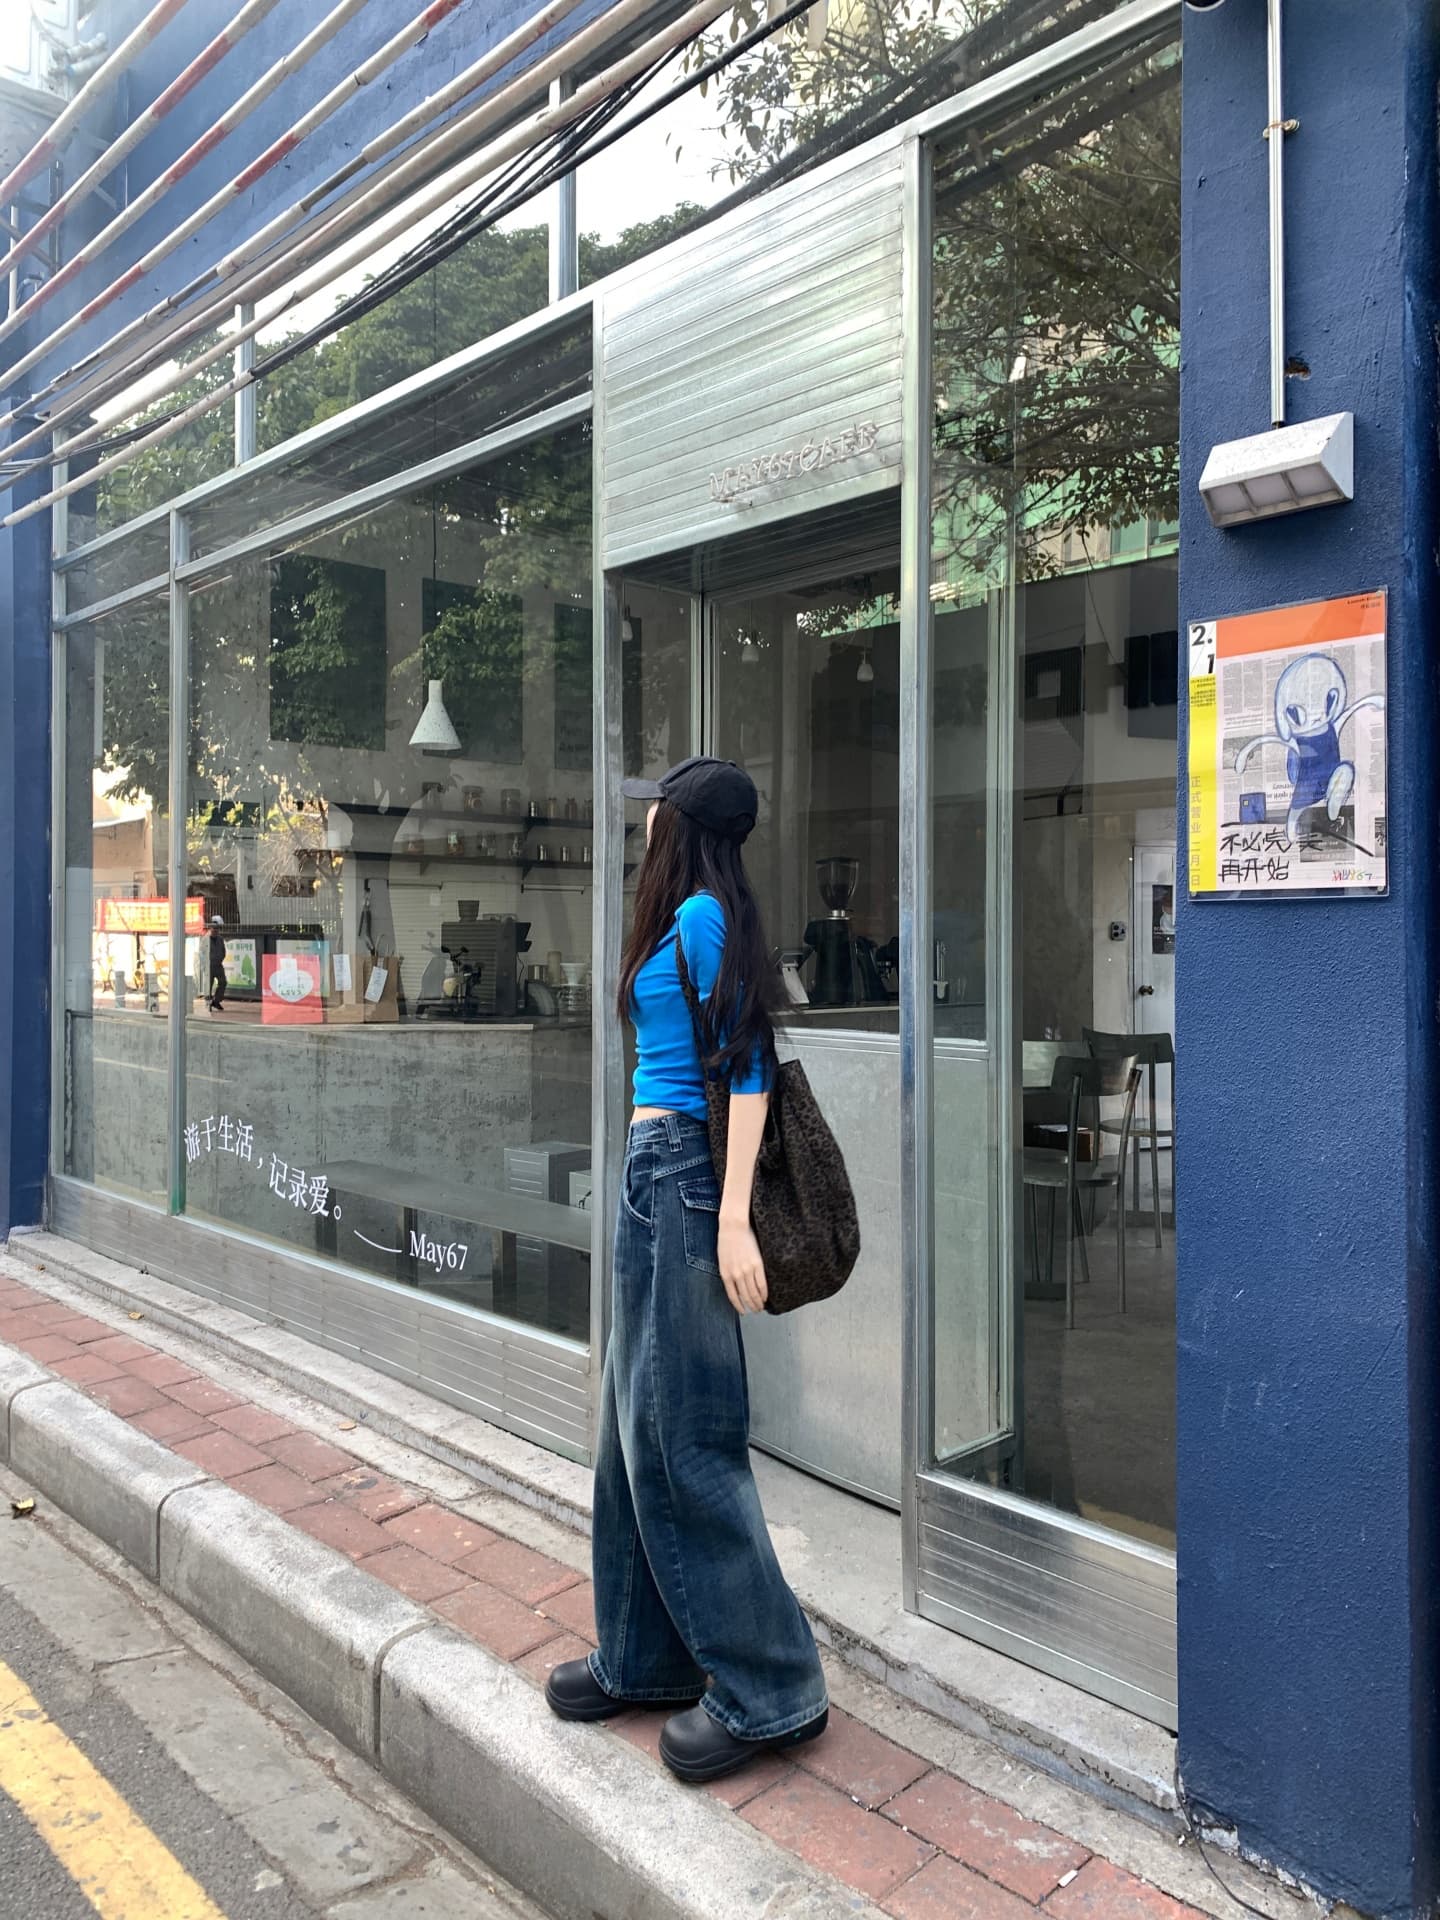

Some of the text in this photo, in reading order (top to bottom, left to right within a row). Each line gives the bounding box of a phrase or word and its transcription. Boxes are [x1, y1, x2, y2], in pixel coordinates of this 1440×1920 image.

[1218, 856, 1290, 883] 再开始
[409, 1229, 468, 1273] May67
